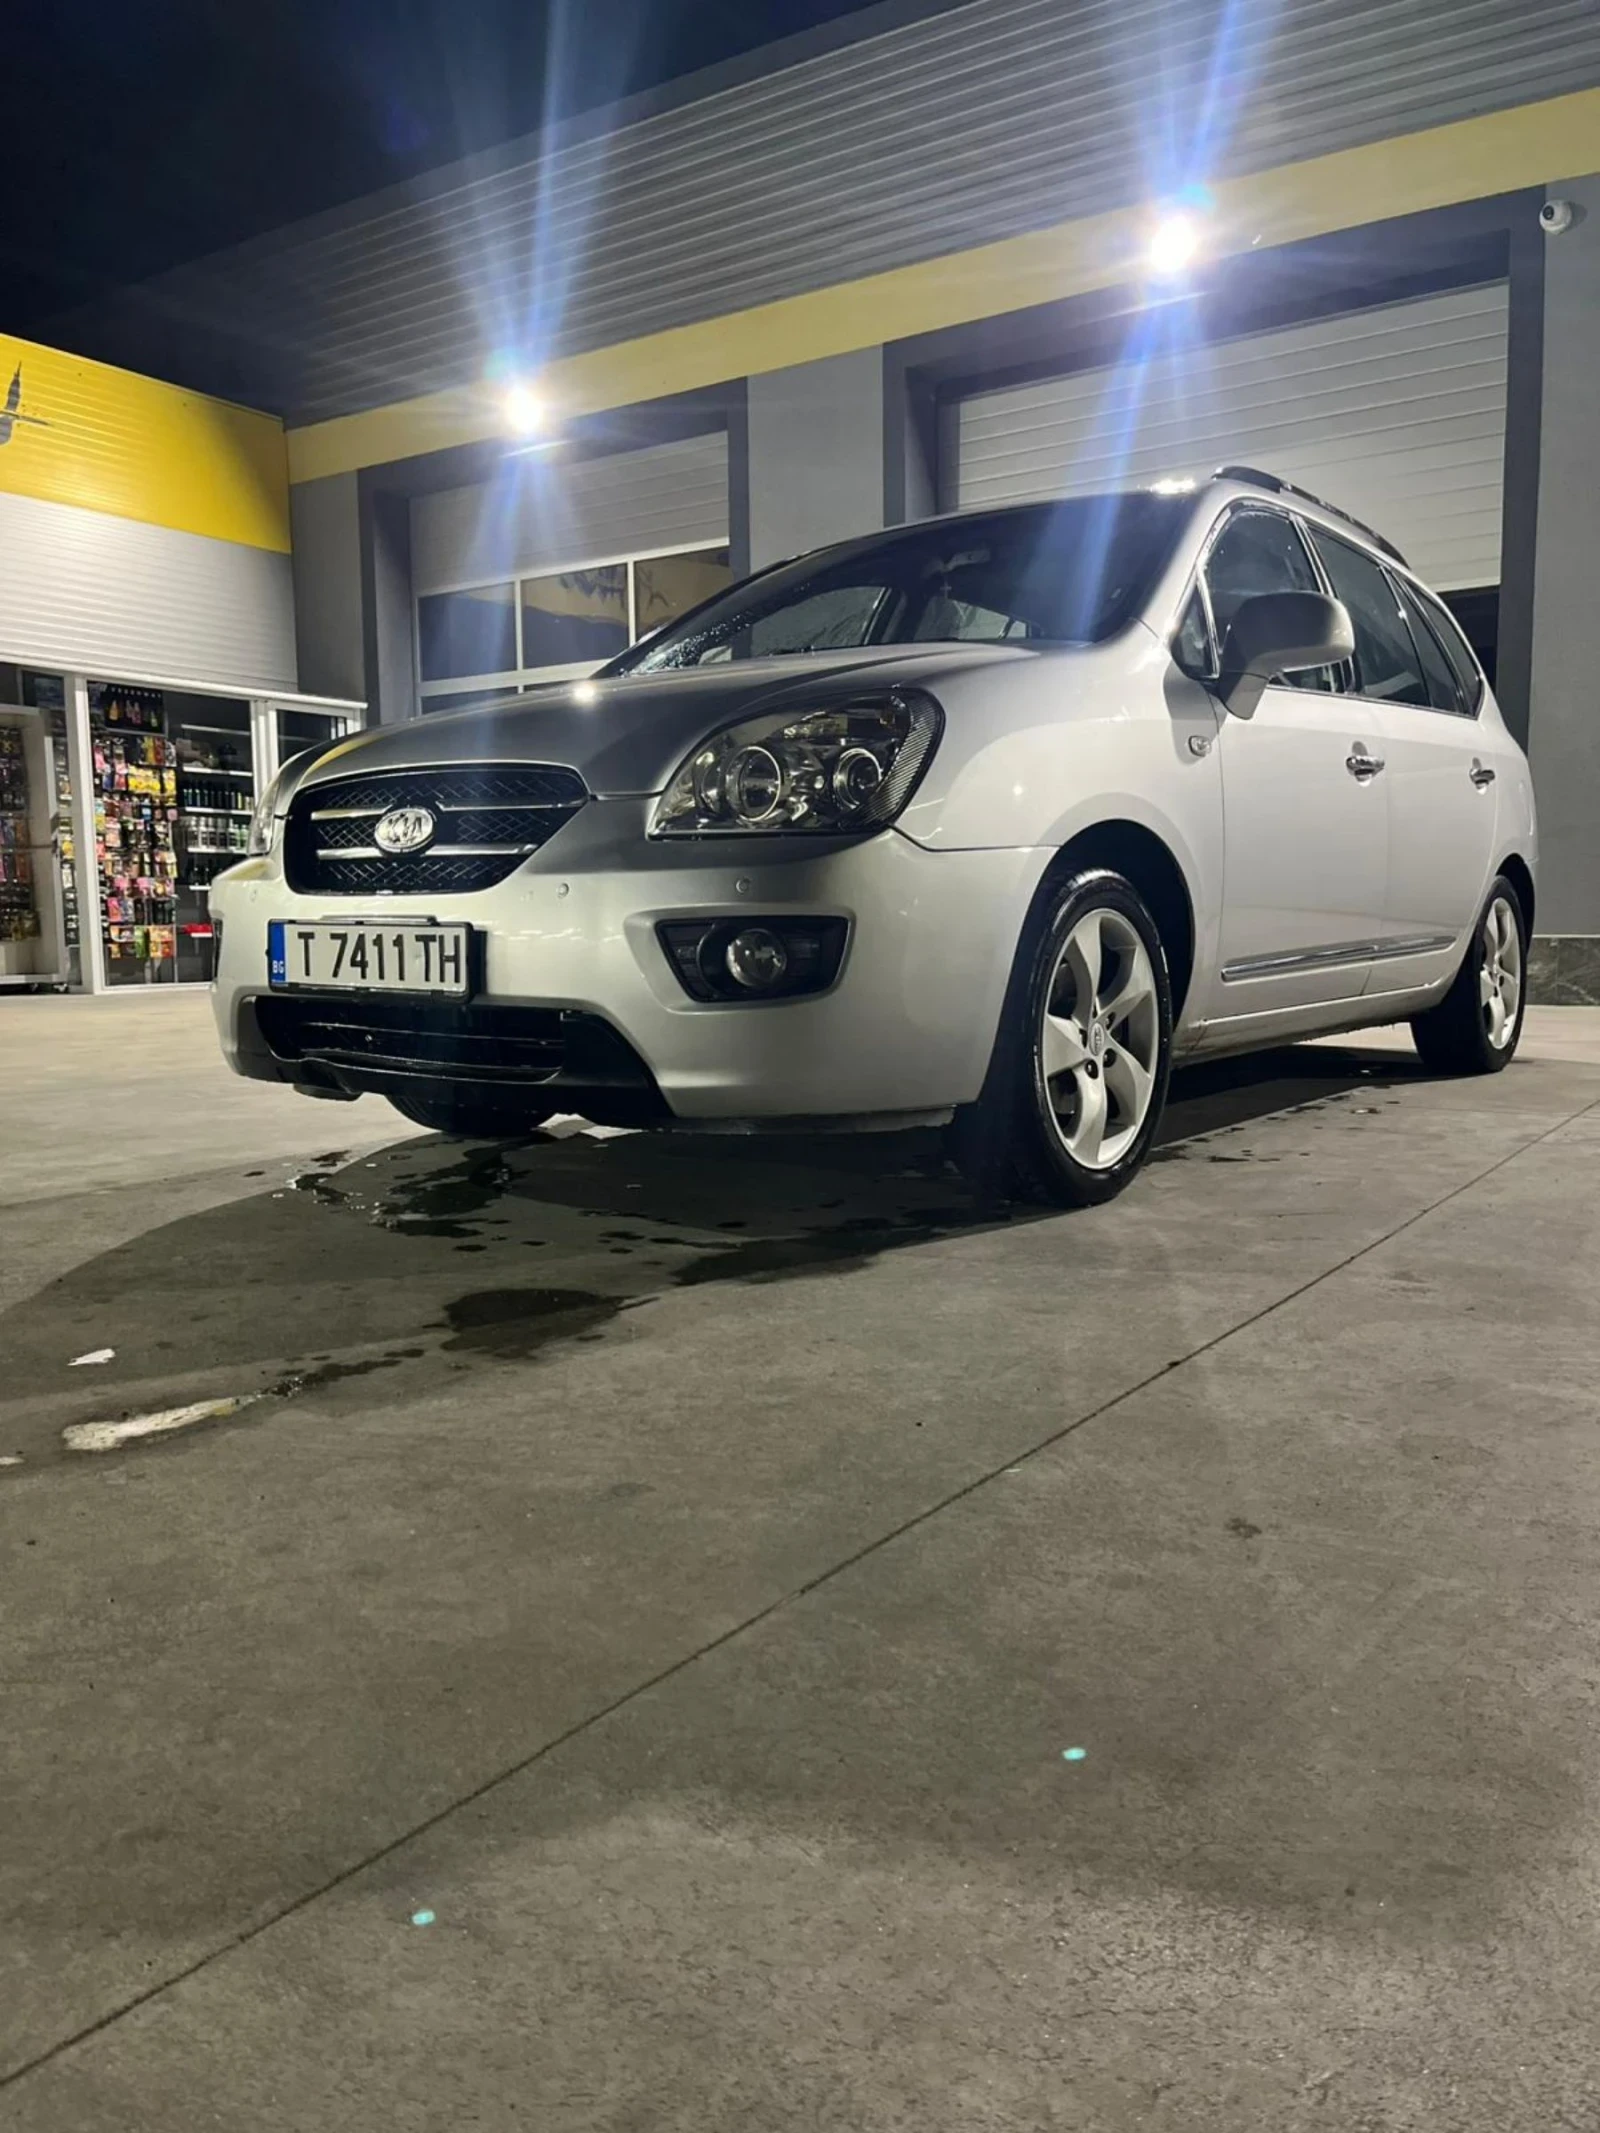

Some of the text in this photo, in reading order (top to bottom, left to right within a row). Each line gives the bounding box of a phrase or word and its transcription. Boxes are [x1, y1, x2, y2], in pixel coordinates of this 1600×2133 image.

[272, 960, 285, 974] BG
[297, 931, 461, 983] T 7411 TH
